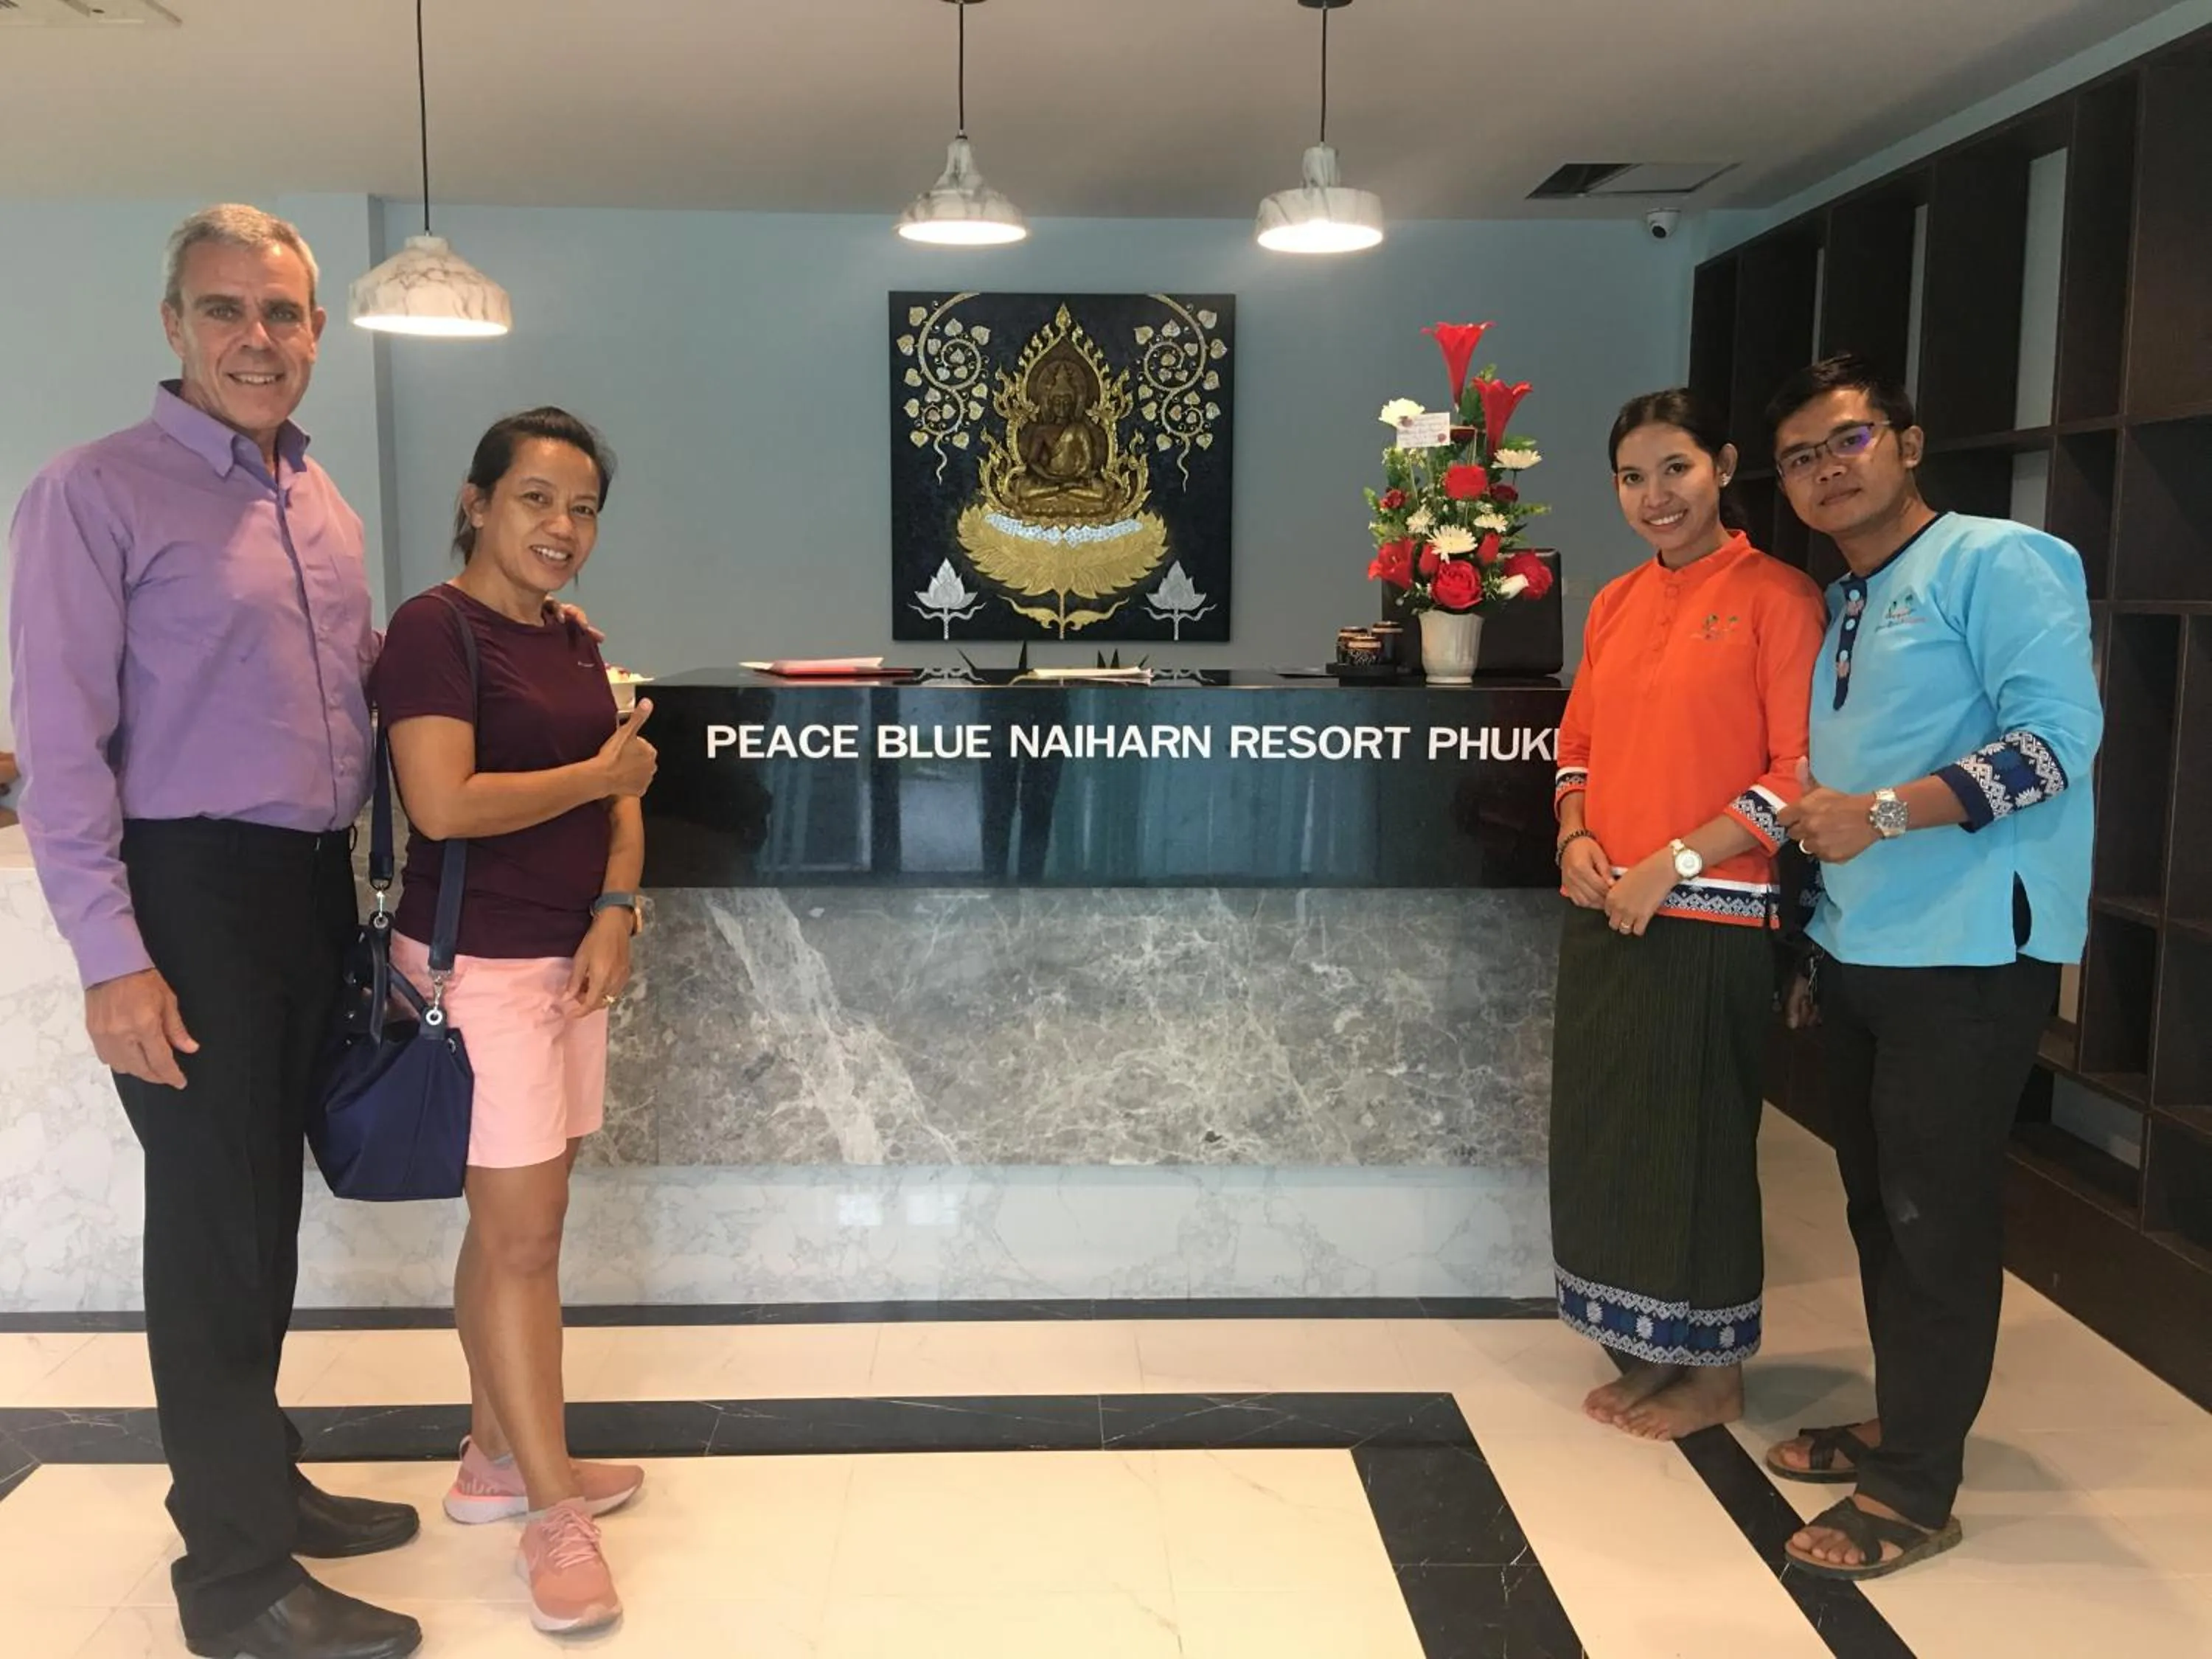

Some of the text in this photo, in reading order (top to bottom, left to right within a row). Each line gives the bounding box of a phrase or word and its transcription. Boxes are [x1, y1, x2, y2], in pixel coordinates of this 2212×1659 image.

[706, 724, 1560, 761] PEACE BLUE NAIHARN RESORT PHUK
